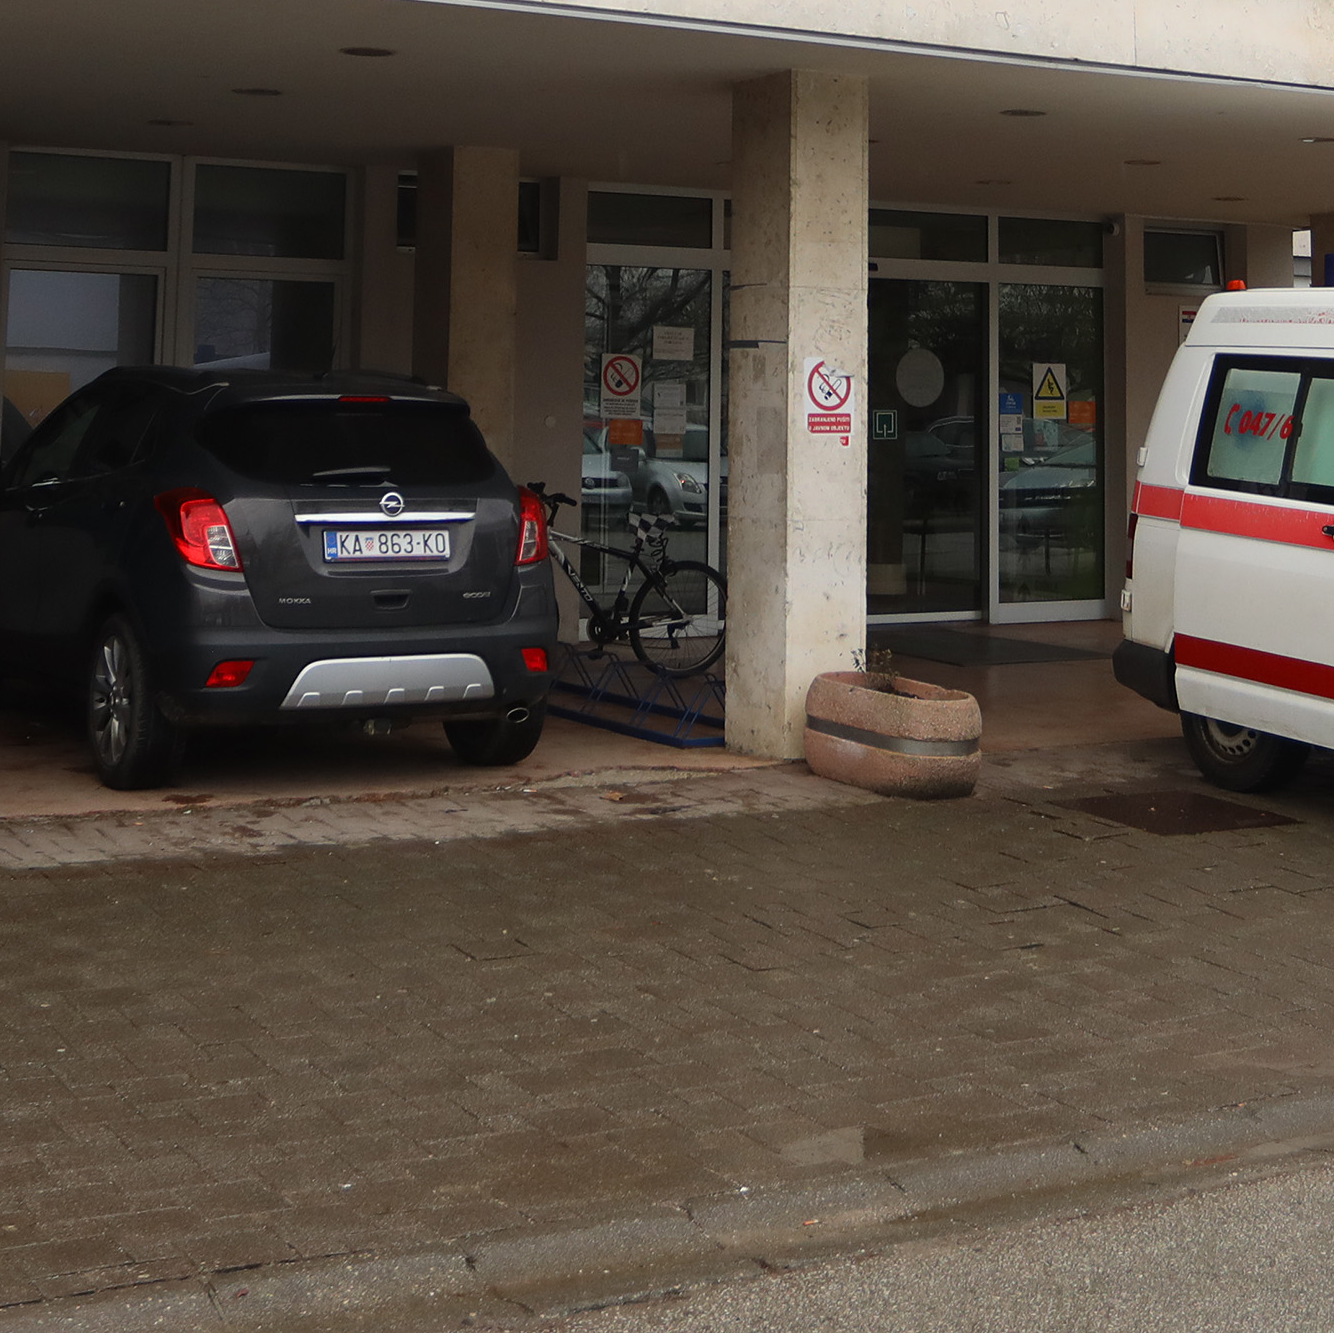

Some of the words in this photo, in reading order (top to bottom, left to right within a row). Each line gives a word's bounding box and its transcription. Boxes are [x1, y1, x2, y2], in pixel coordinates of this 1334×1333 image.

[339, 534, 363, 555] KA
[378, 532, 446, 555] 863-KO
[278, 597, 312, 605] MOKKA
